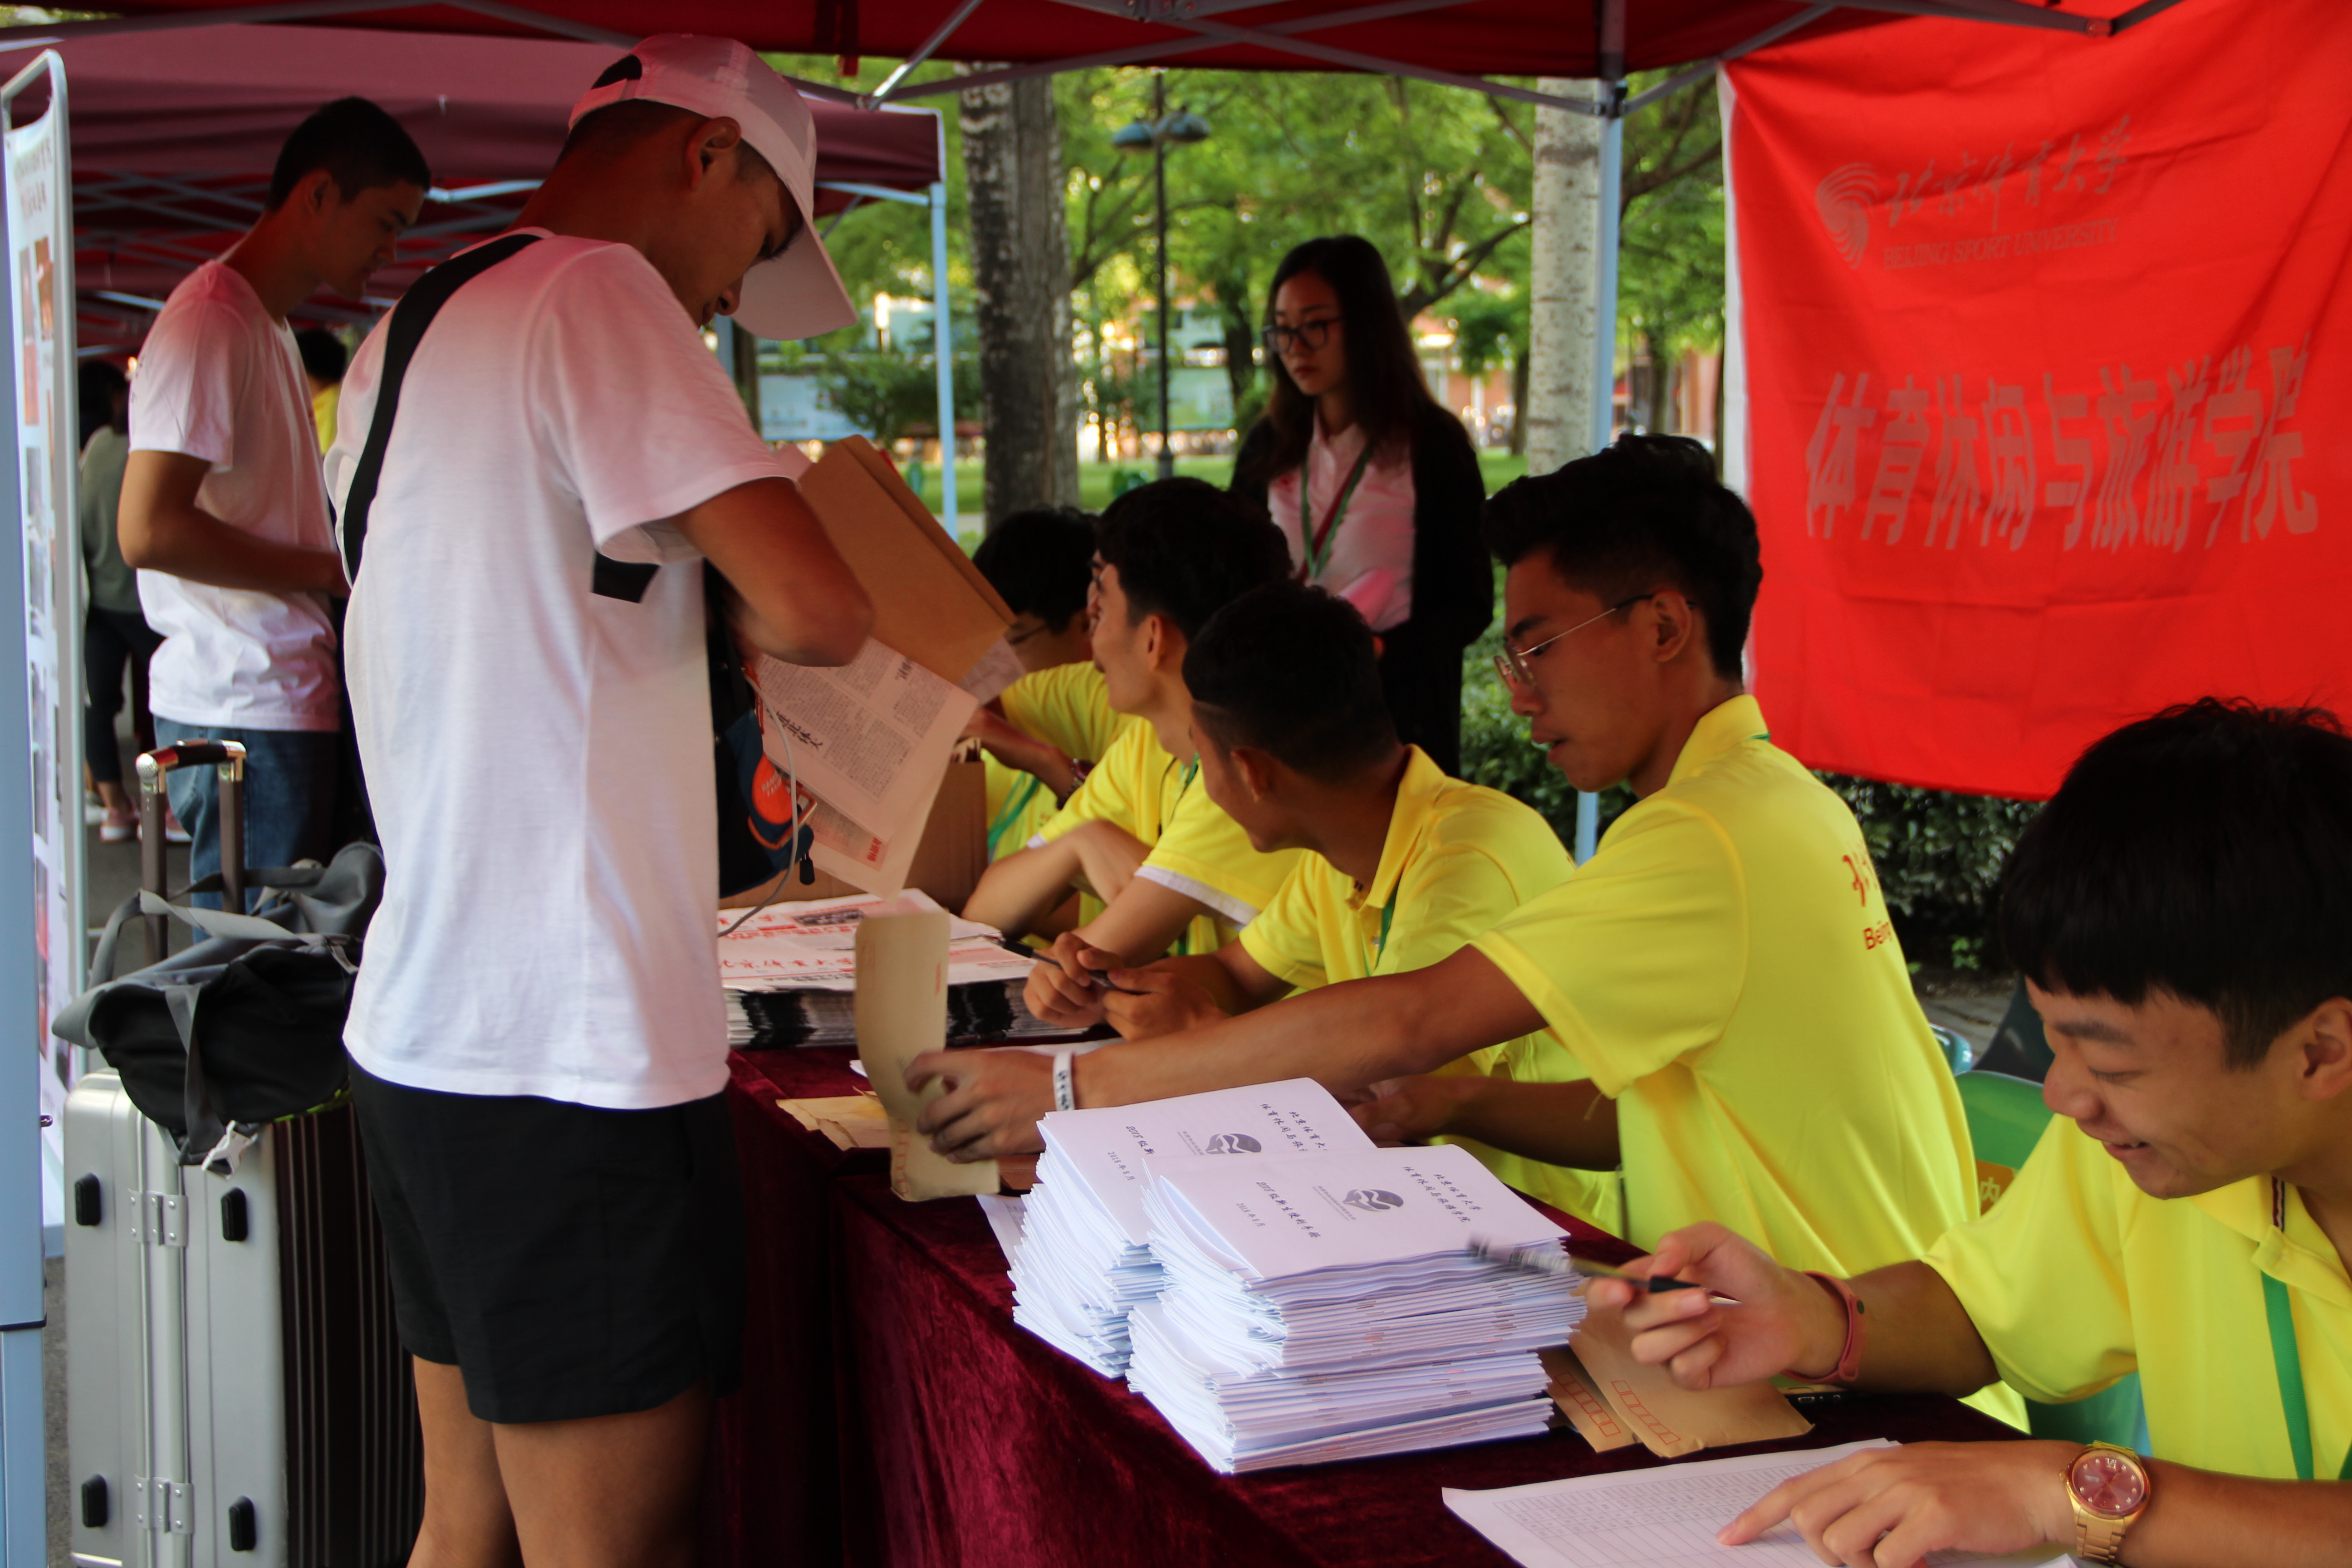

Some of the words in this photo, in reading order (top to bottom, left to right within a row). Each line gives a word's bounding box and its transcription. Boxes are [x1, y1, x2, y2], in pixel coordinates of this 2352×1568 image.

[1884, 114, 2131, 232] 北京体育大学
[1883, 241, 1950, 270] BEIJING
[1952, 234, 2011, 263] SPORT
[2014, 217, 2119, 256] UNIVERSITY
[1805, 331, 2319, 554] 体育休闲与旅游学院
[1289, 1111, 1328, 1151] 北京体育大
[1107, 1151, 1135, 1180] 2018年8月
[1236, 1203, 1266, 1226] 2018年8月
[1402, 1166, 1471, 1222] 体育休闲与旅游学院
[1433, 1174, 1483, 1210] 北京体育大学
